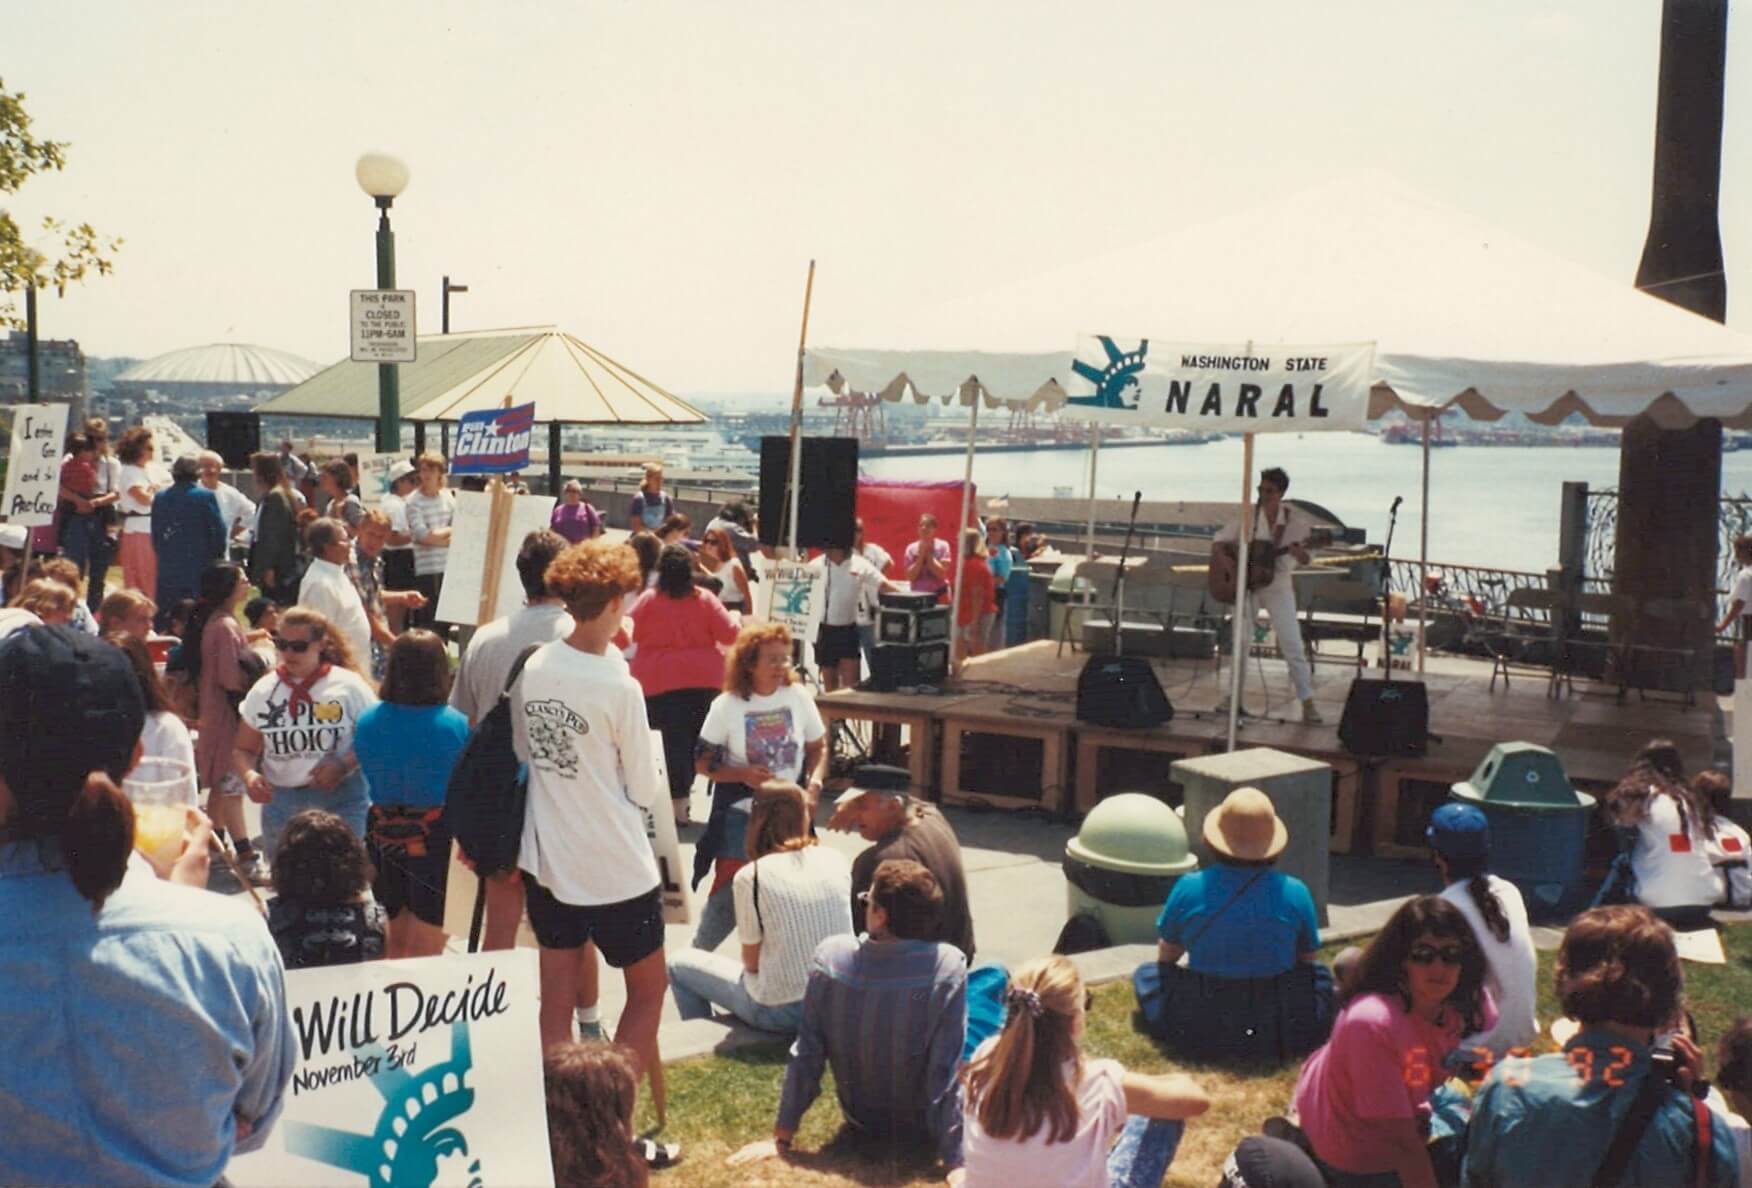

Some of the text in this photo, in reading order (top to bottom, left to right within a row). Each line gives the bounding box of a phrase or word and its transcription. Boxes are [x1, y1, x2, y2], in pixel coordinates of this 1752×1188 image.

[360, 294, 406, 303] THIS PARK
[365, 310, 400, 320] CLOSED
[1181, 354, 1328, 372] WASHINGTON STATE
[1165, 379, 1329, 418] NARAL
[456, 430, 530, 456] Clinton
[293, 967, 510, 1061] Will Decide
[293, 1041, 418, 1096] November 3rd
